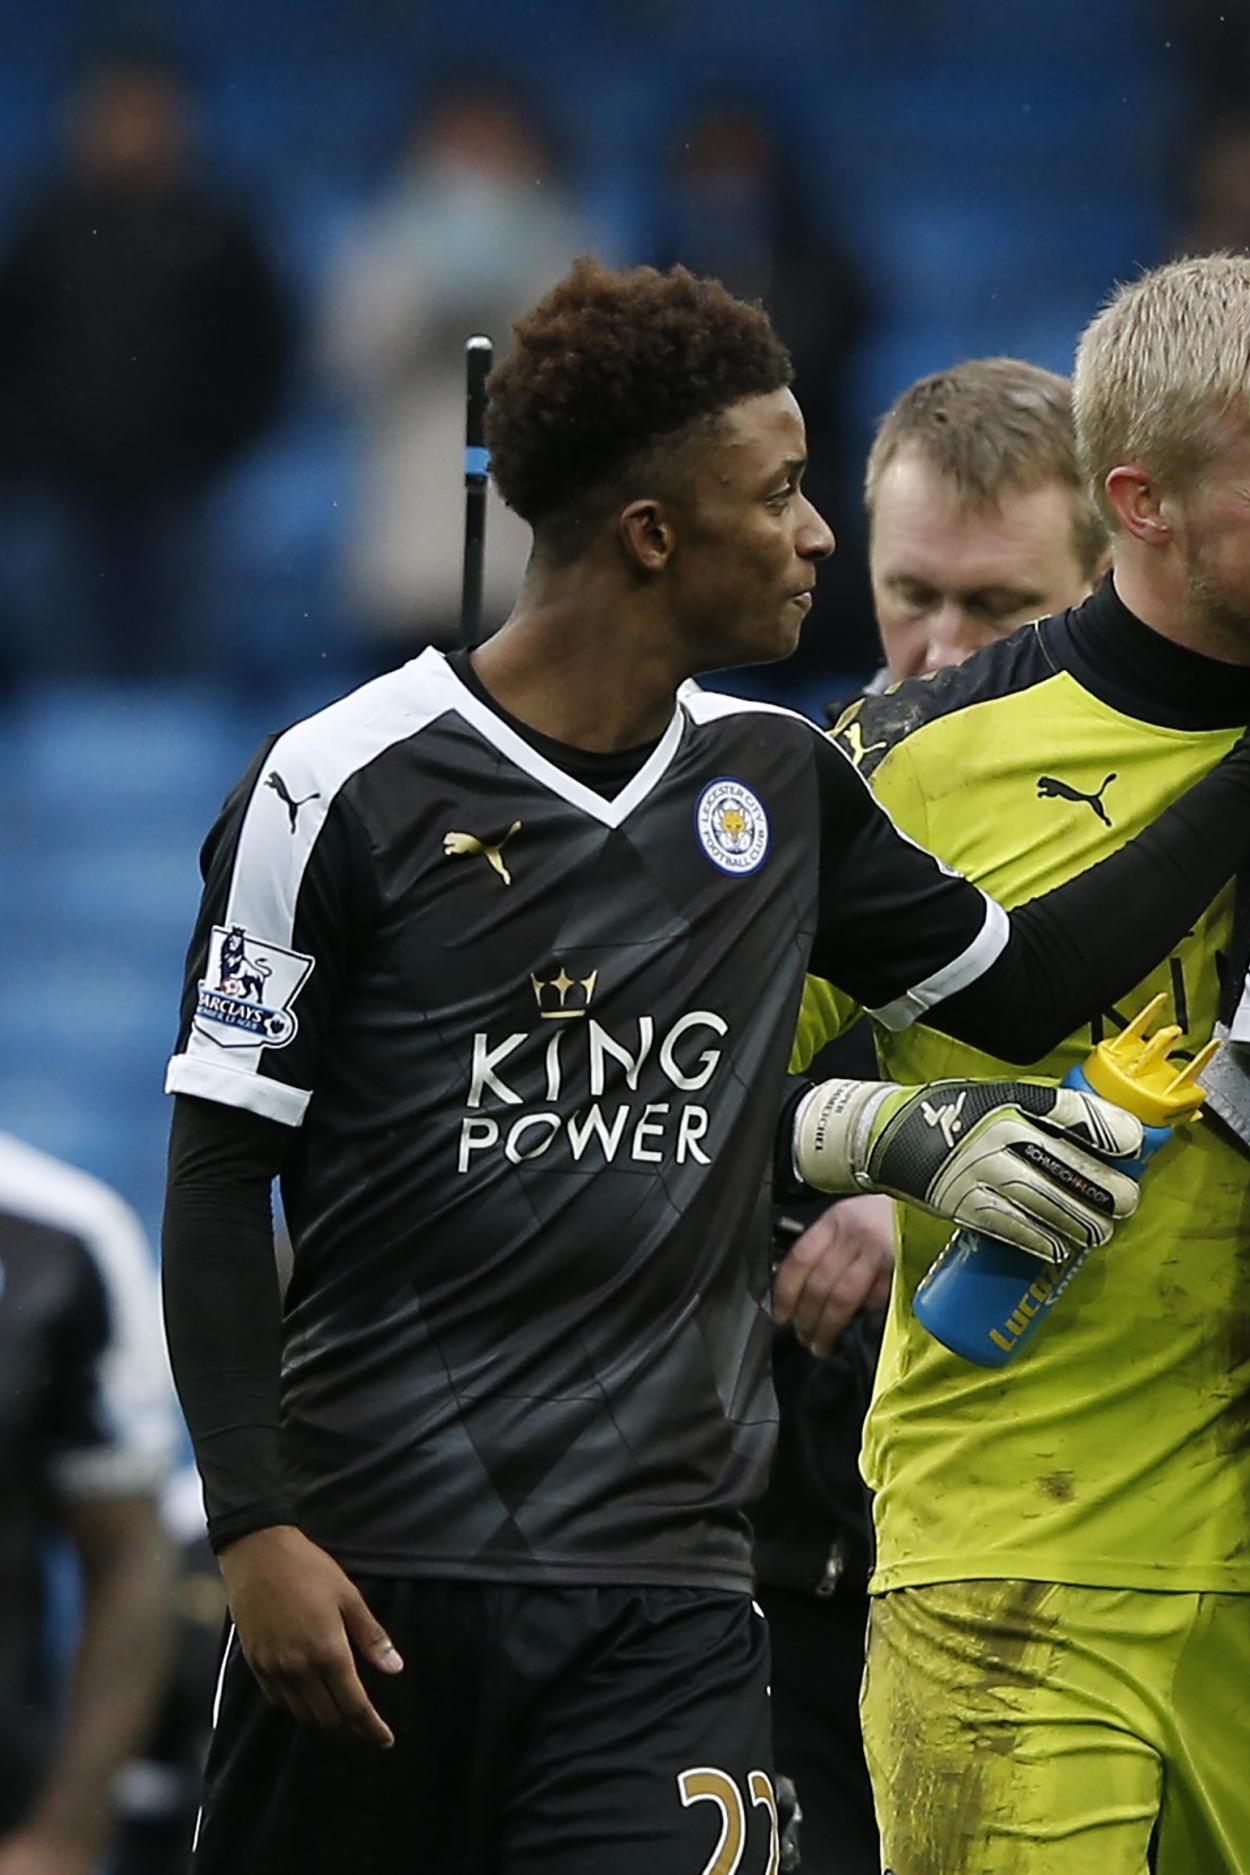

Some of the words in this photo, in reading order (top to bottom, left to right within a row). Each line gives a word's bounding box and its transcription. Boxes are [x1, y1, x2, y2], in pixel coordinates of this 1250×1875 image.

[702, 785, 745, 823] LEICESTER
[198, 993, 264, 1023] ARCLAYS
[466, 1010, 731, 1109] KING
[456, 1102, 713, 1174] POWER
